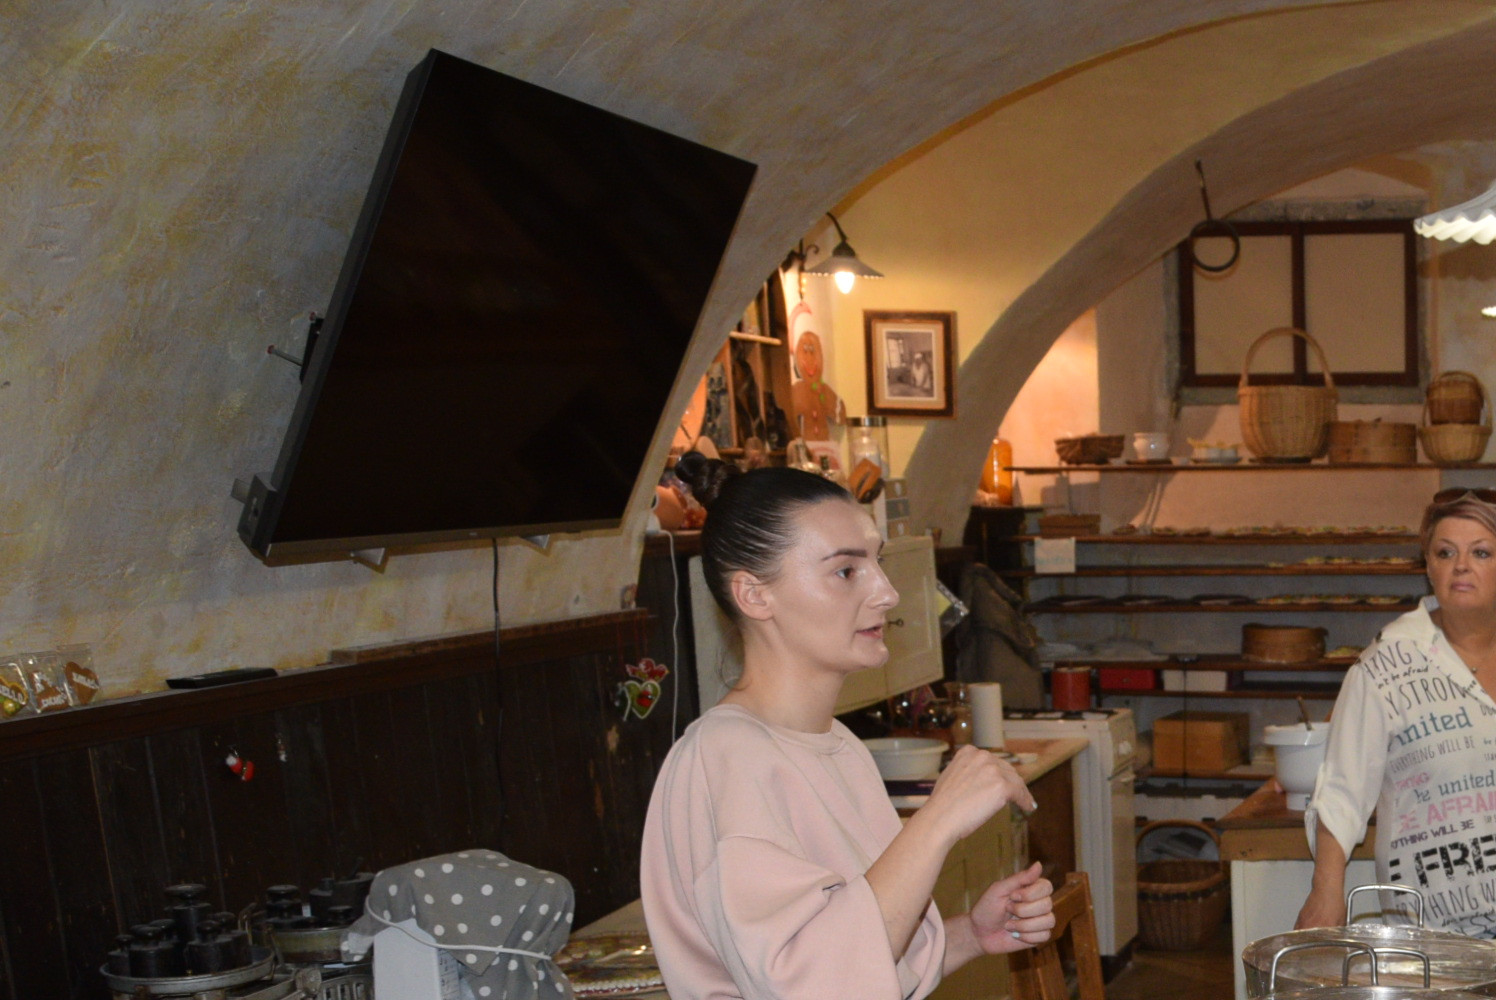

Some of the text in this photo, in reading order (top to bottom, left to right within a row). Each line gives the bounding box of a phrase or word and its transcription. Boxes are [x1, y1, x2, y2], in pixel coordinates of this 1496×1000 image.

[1436, 734, 1462, 755] WILL
[1463, 733, 1476, 749] BE
[1438, 769, 1496, 797] united
[1430, 823, 1459, 838] WILL
